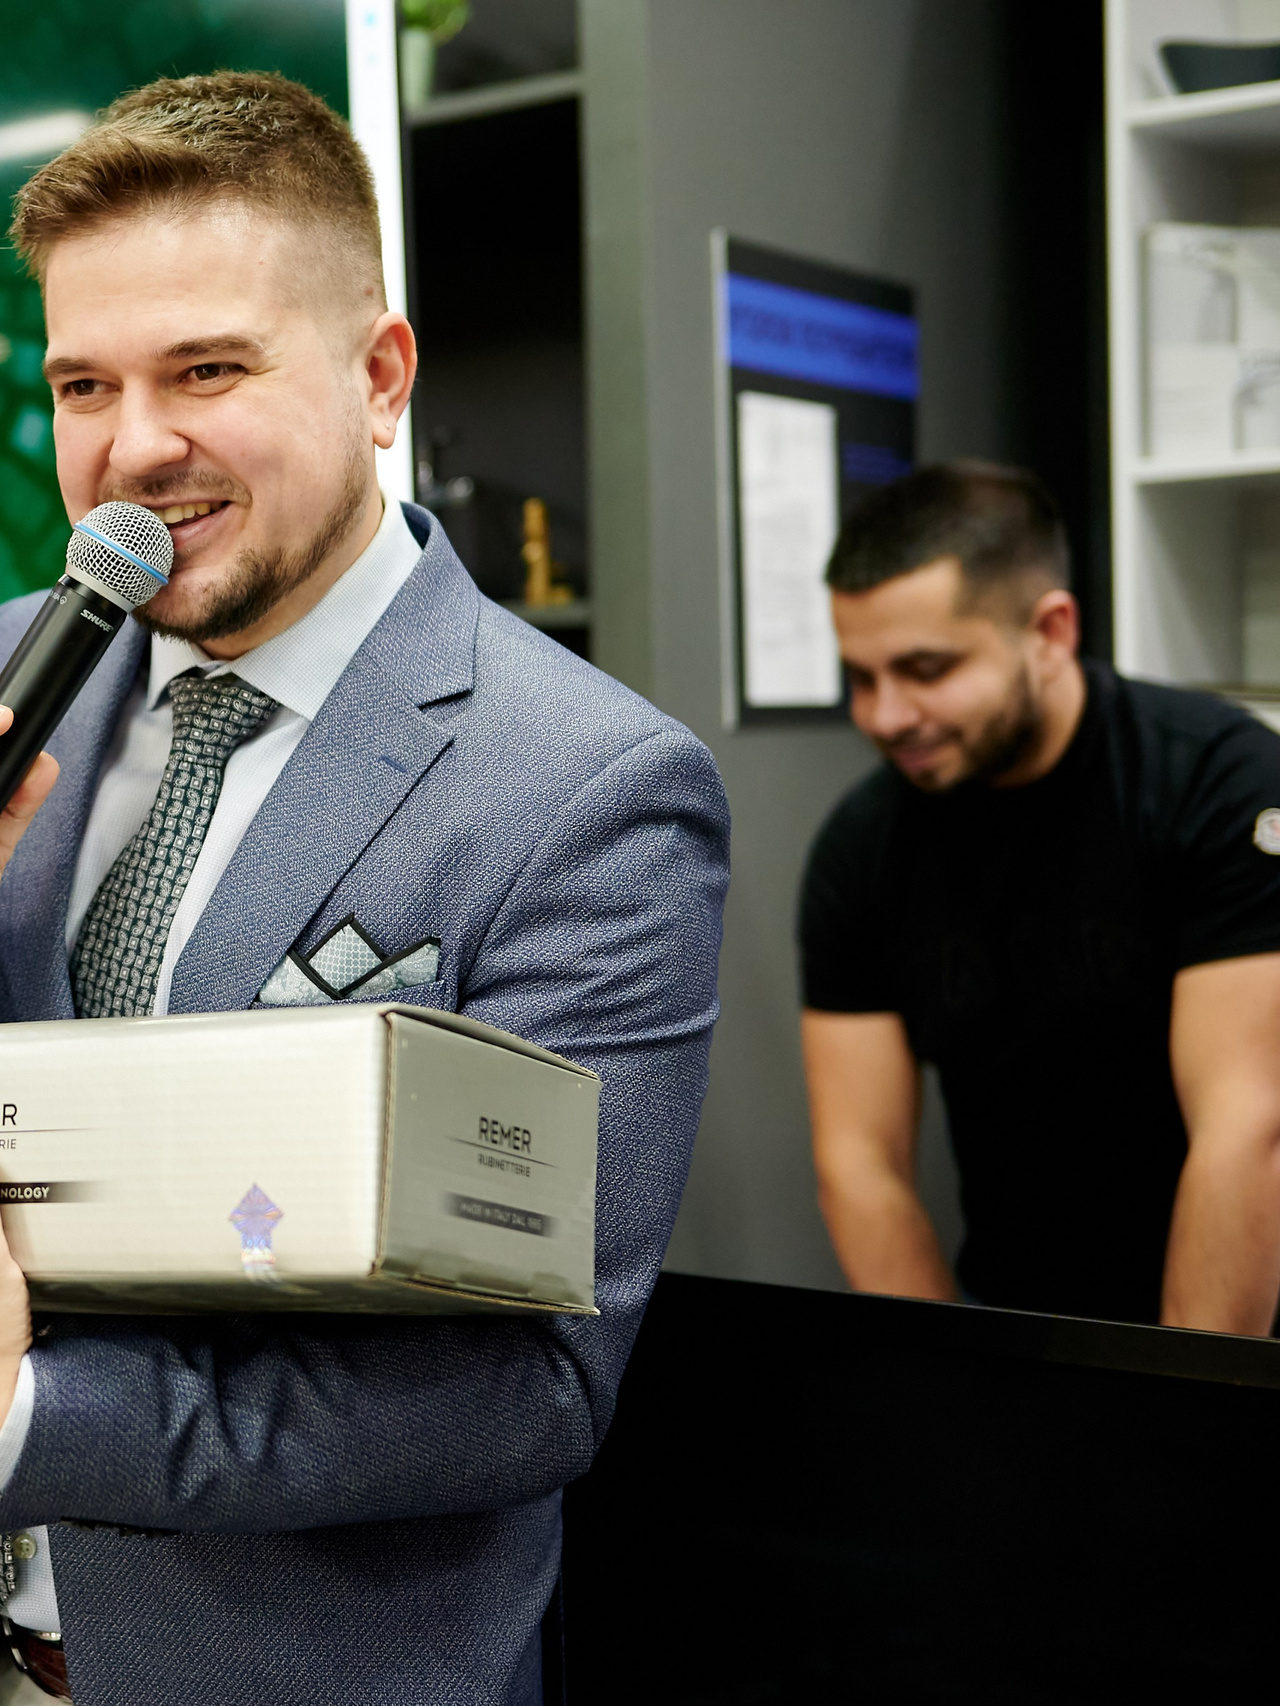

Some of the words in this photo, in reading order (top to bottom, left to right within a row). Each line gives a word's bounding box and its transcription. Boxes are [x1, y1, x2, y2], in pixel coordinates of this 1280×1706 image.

[80, 609, 112, 632] SHURE
[478, 1116, 531, 1154] REMER
[478, 1153, 531, 1177] RUBINETTERIE
[0, 1186, 50, 1199] NOLOGY
